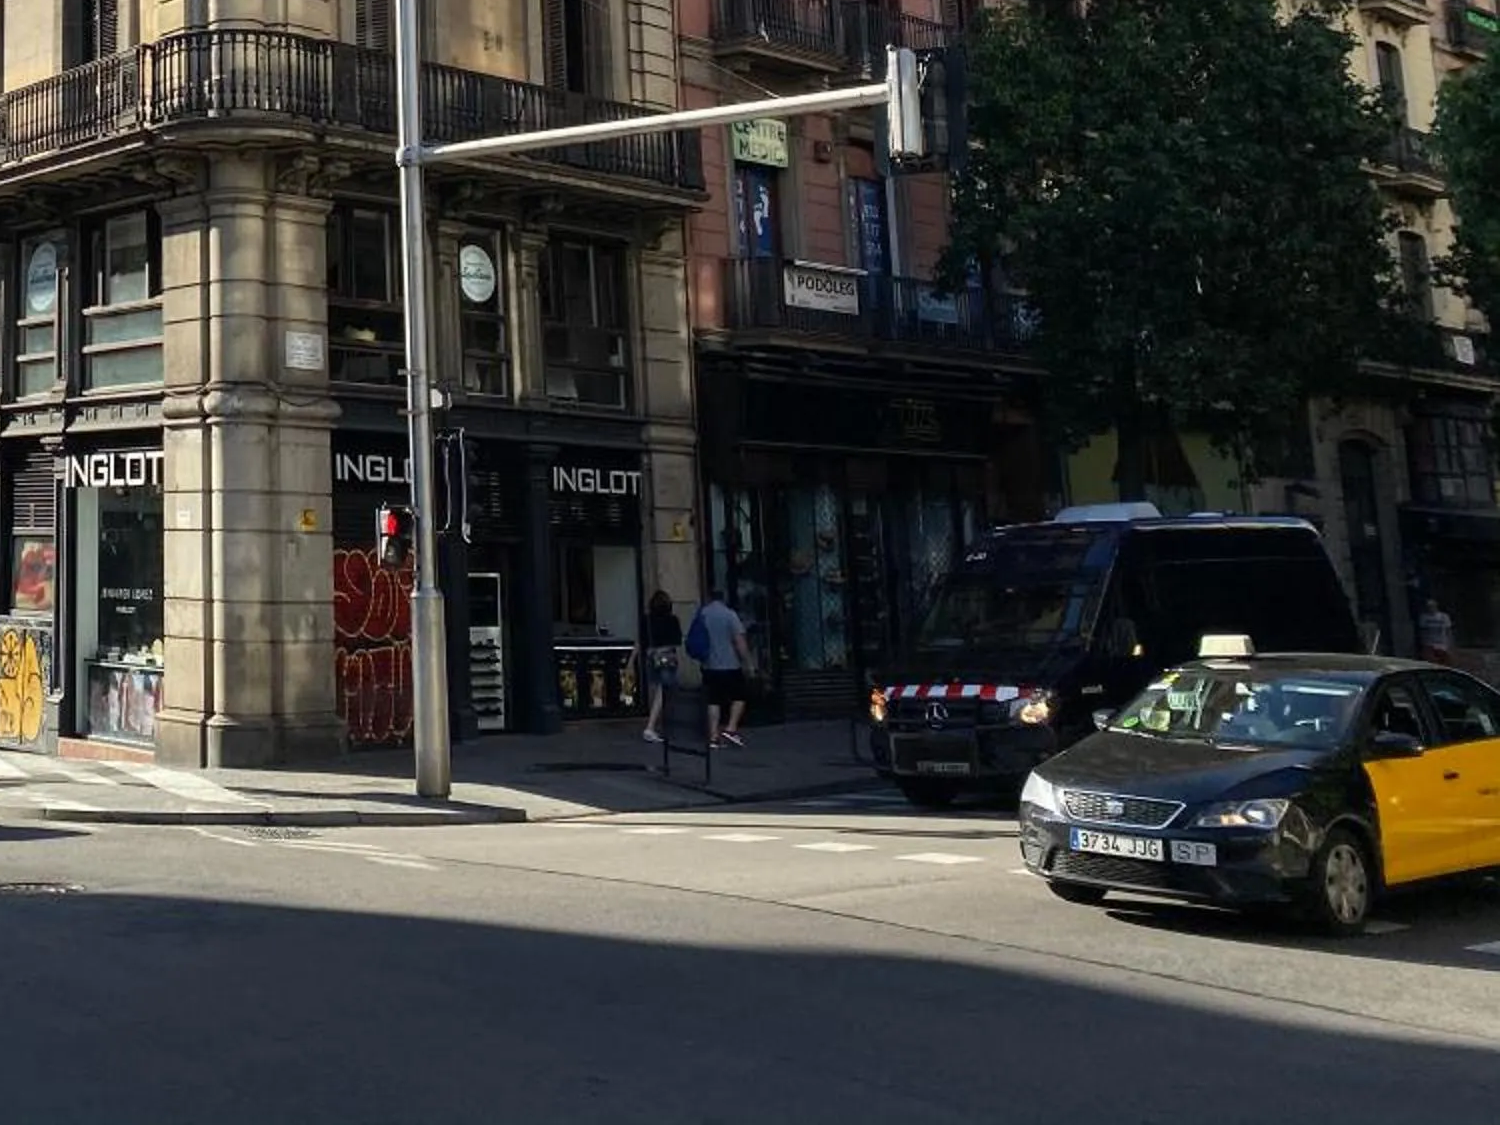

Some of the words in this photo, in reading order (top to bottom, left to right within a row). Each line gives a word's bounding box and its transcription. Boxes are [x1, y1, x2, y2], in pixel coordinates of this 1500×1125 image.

[65, 452, 164, 488] INGLOT
[553, 466, 641, 495] INGLOT
[1081, 832, 1120, 852] 3734
[1128, 839, 1159, 858] JJG
[1177, 844, 1209, 860] SP
